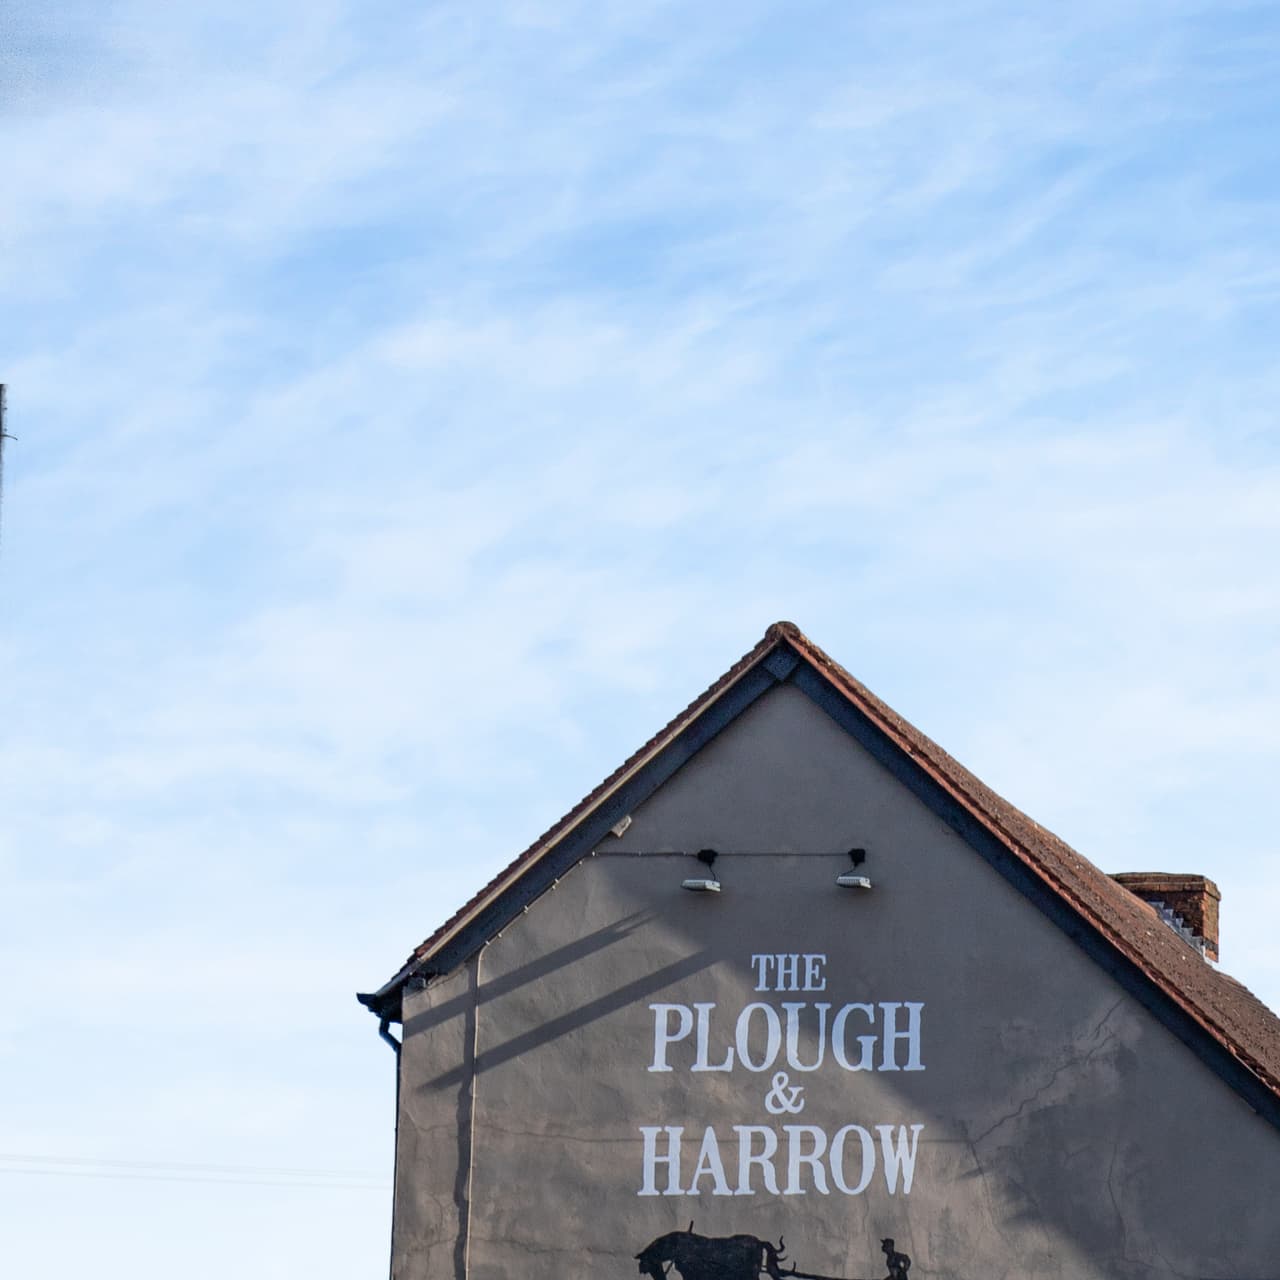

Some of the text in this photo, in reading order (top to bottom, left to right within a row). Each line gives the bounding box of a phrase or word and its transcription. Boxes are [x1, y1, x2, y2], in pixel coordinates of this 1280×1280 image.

[751, 953, 827, 992] THE
[647, 1001, 926, 1072] PLOUGH
[765, 1071, 805, 1114] &
[637, 1123, 925, 1196] HARROW
